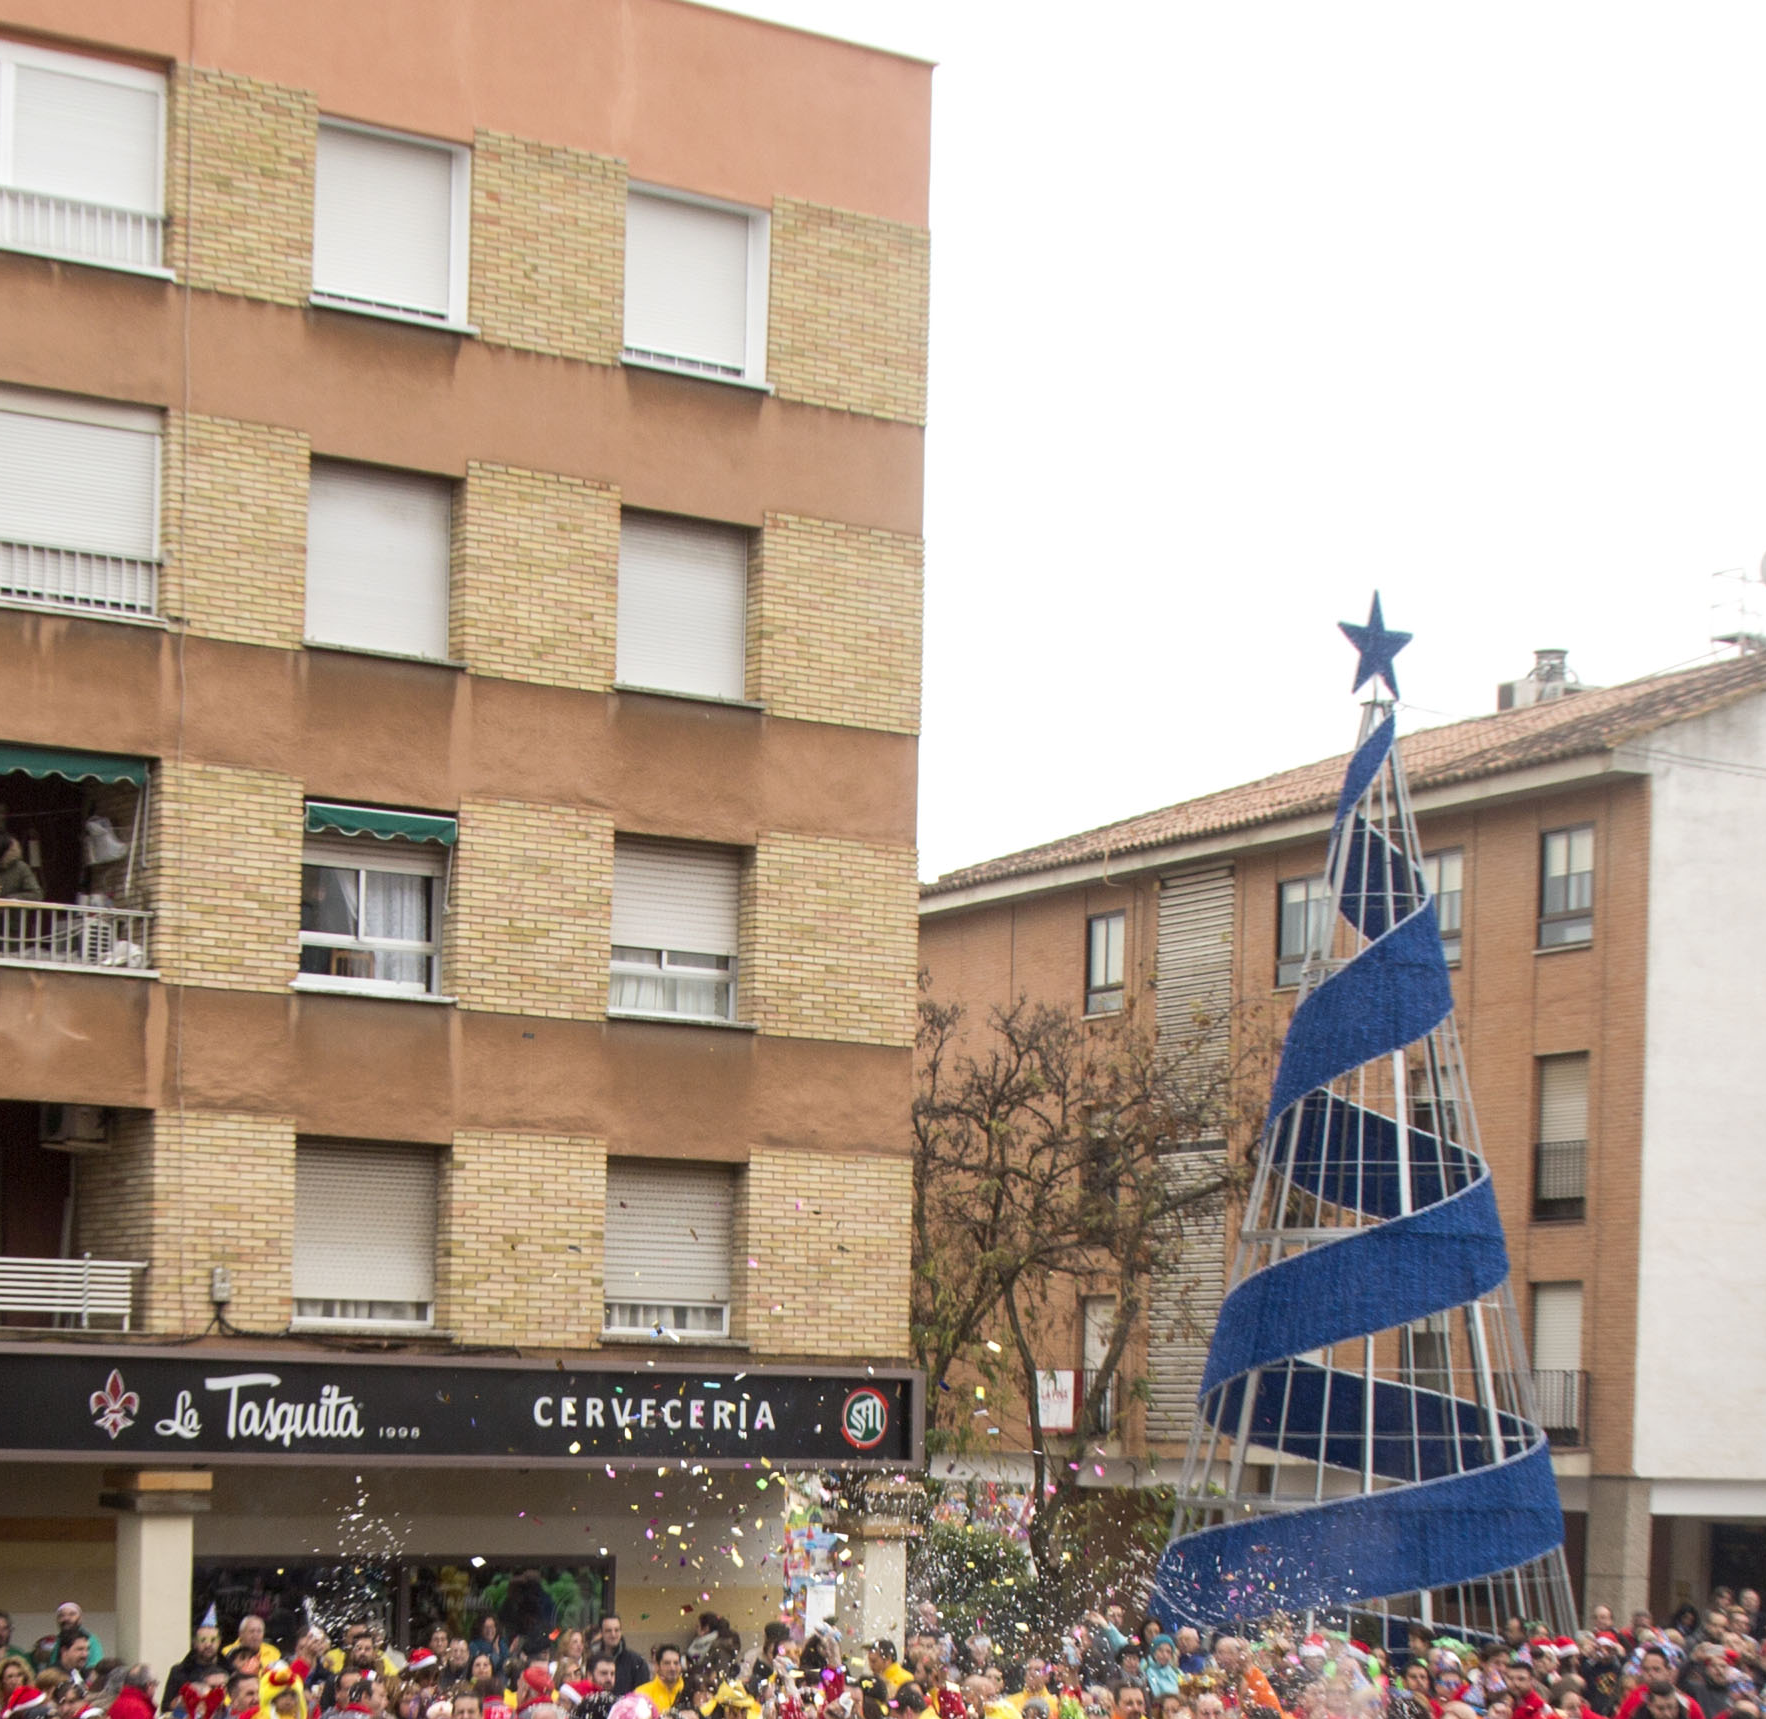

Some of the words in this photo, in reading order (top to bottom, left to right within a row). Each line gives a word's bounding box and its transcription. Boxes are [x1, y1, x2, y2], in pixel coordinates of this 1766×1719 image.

[154, 1390, 202, 1439] La
[204, 1373, 365, 1448] Tasquita
[379, 1426, 421, 1439] 1998
